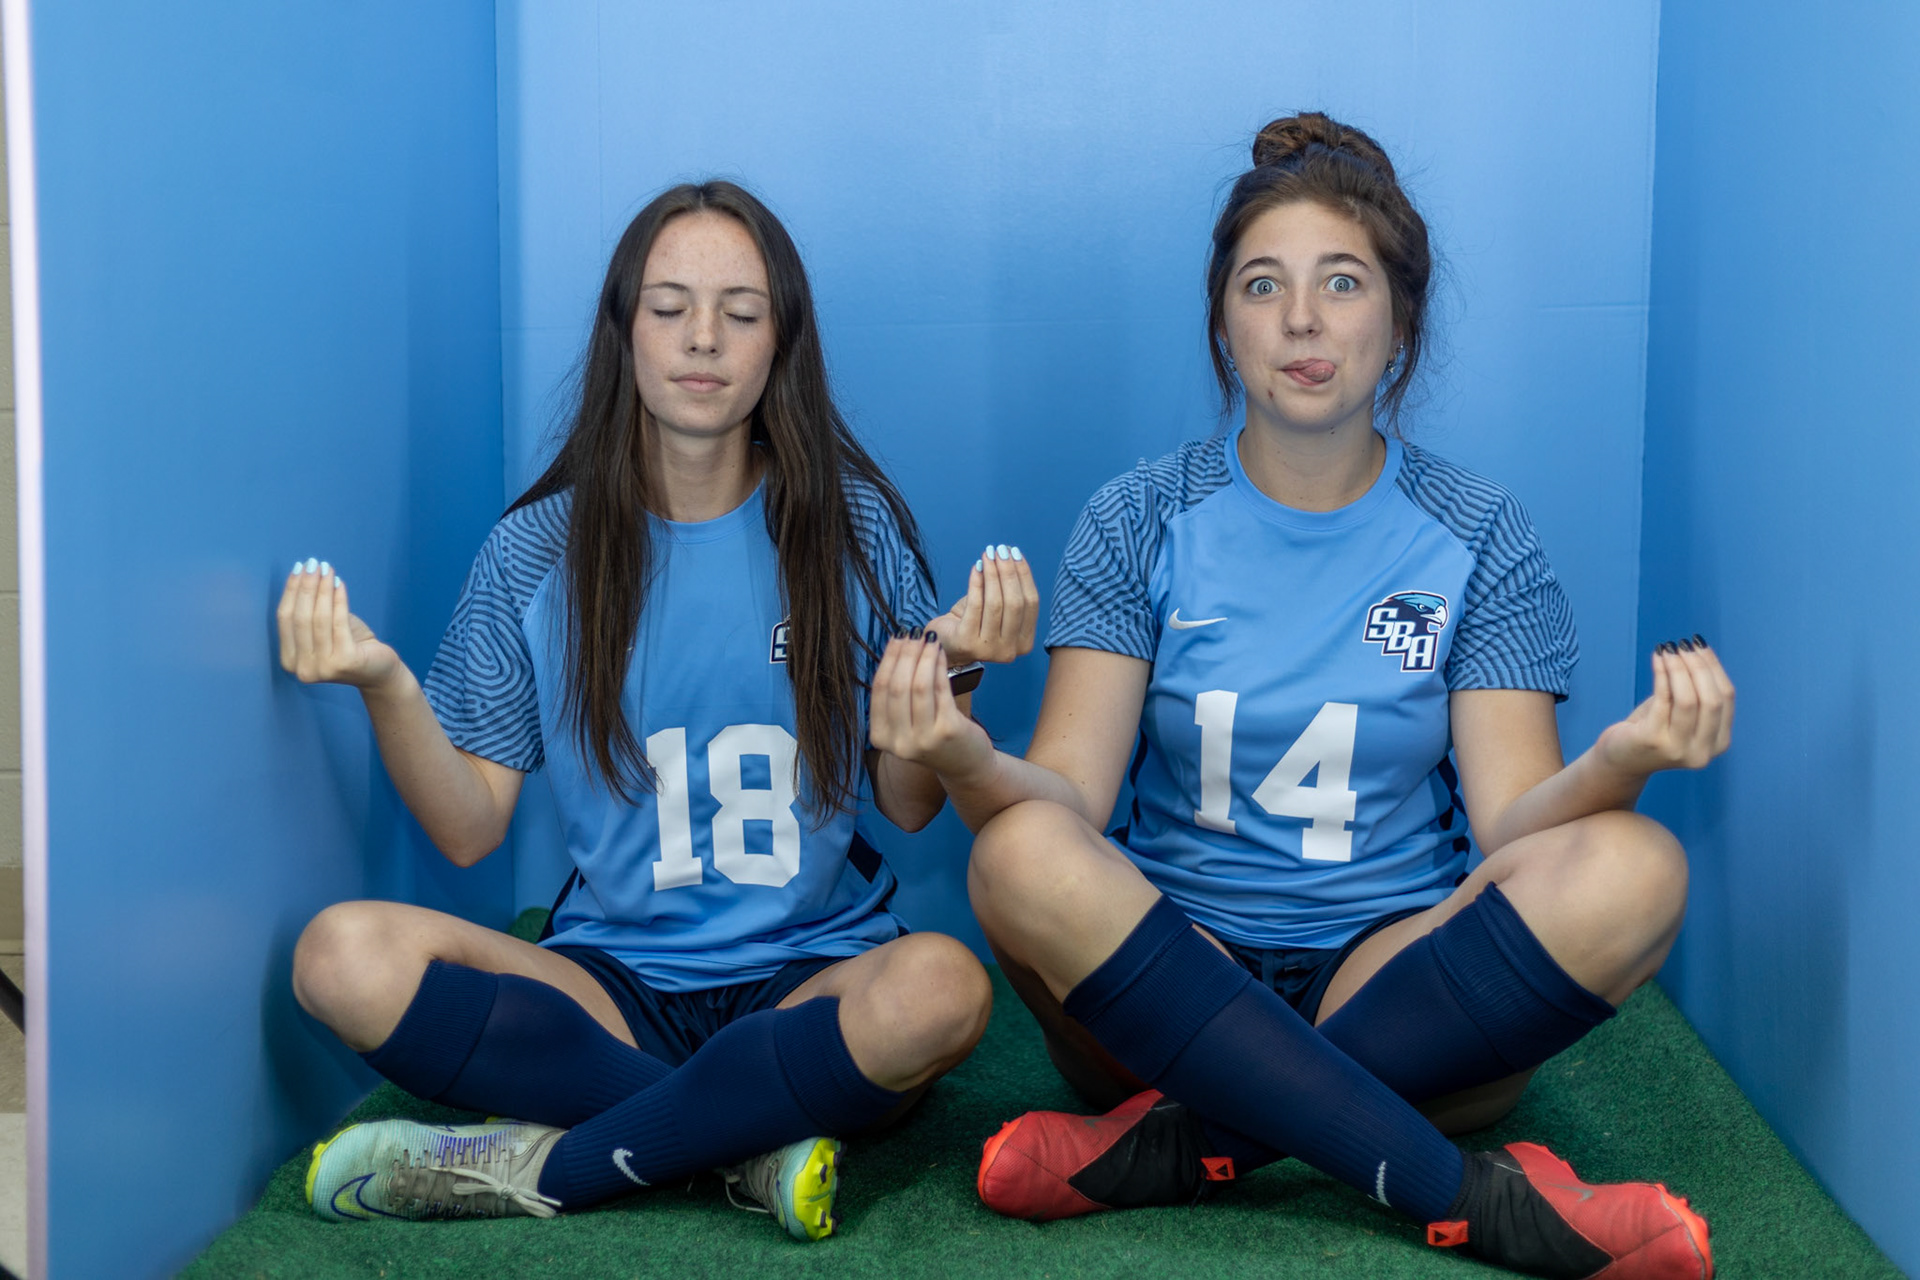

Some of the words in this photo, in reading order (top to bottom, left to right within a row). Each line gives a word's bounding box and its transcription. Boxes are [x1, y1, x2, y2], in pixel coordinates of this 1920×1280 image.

[1367, 606, 1436, 668] SBA
[646, 723, 801, 892] 18
[1194, 689, 1358, 862] 14
